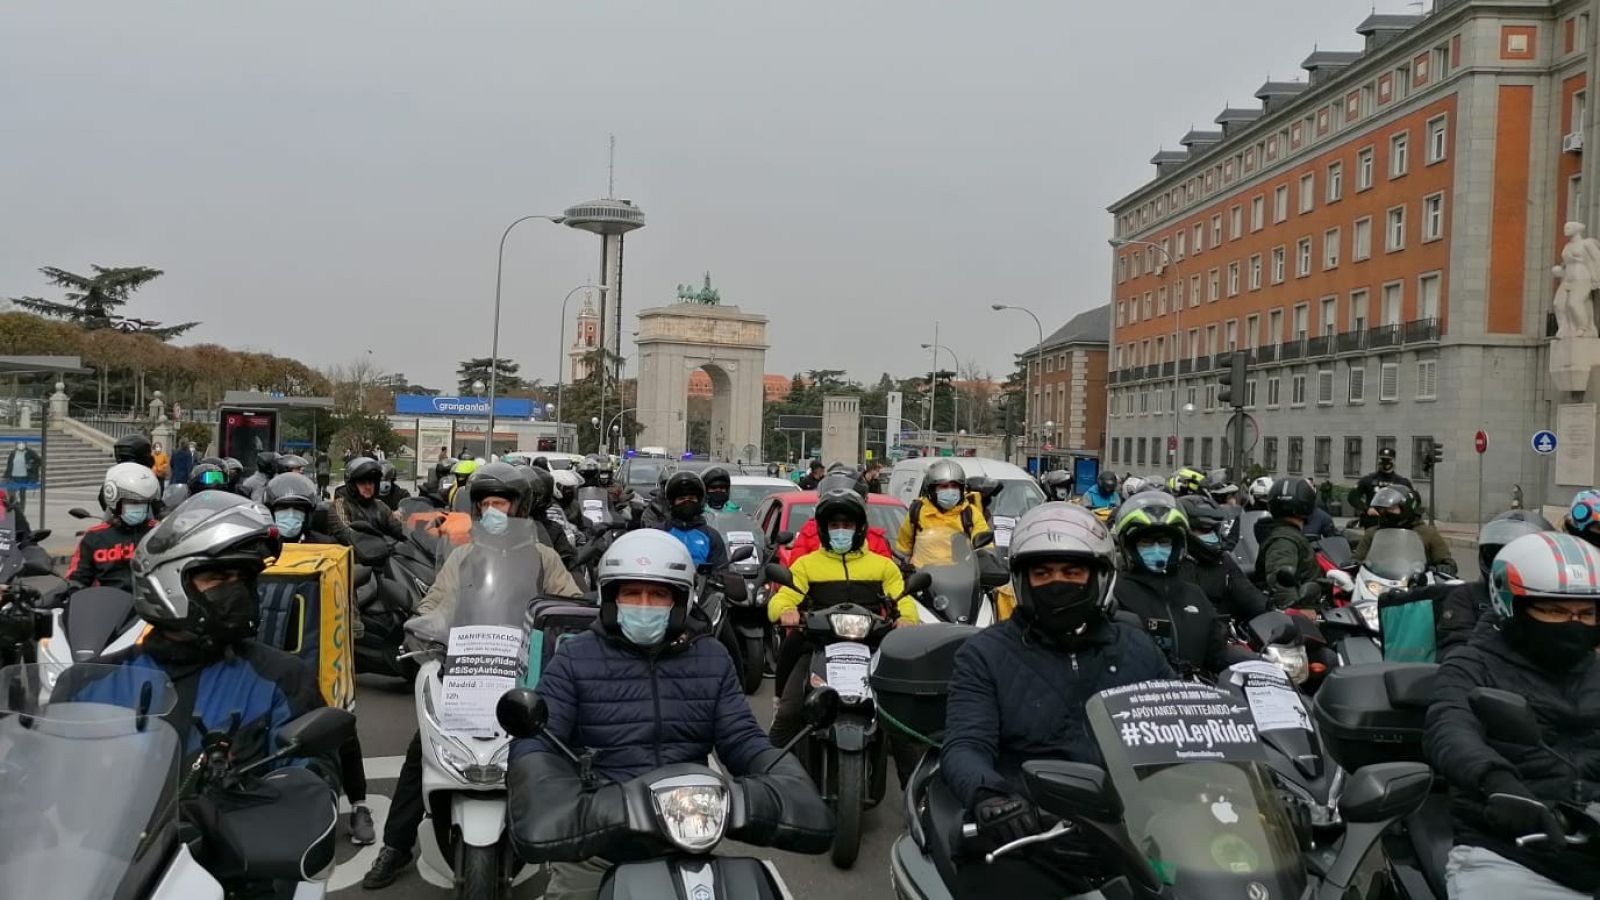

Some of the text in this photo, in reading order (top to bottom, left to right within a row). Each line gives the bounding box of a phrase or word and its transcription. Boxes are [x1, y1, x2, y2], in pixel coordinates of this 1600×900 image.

[457, 633, 521, 643] MANIFESTACIÓN
[455, 656, 516, 666] #StopLeyRider
[448, 680, 477, 688] Madrid
[1178, 703, 1230, 717] TWITTEANDO
[1120, 719, 1257, 748] #StopLeyRider
